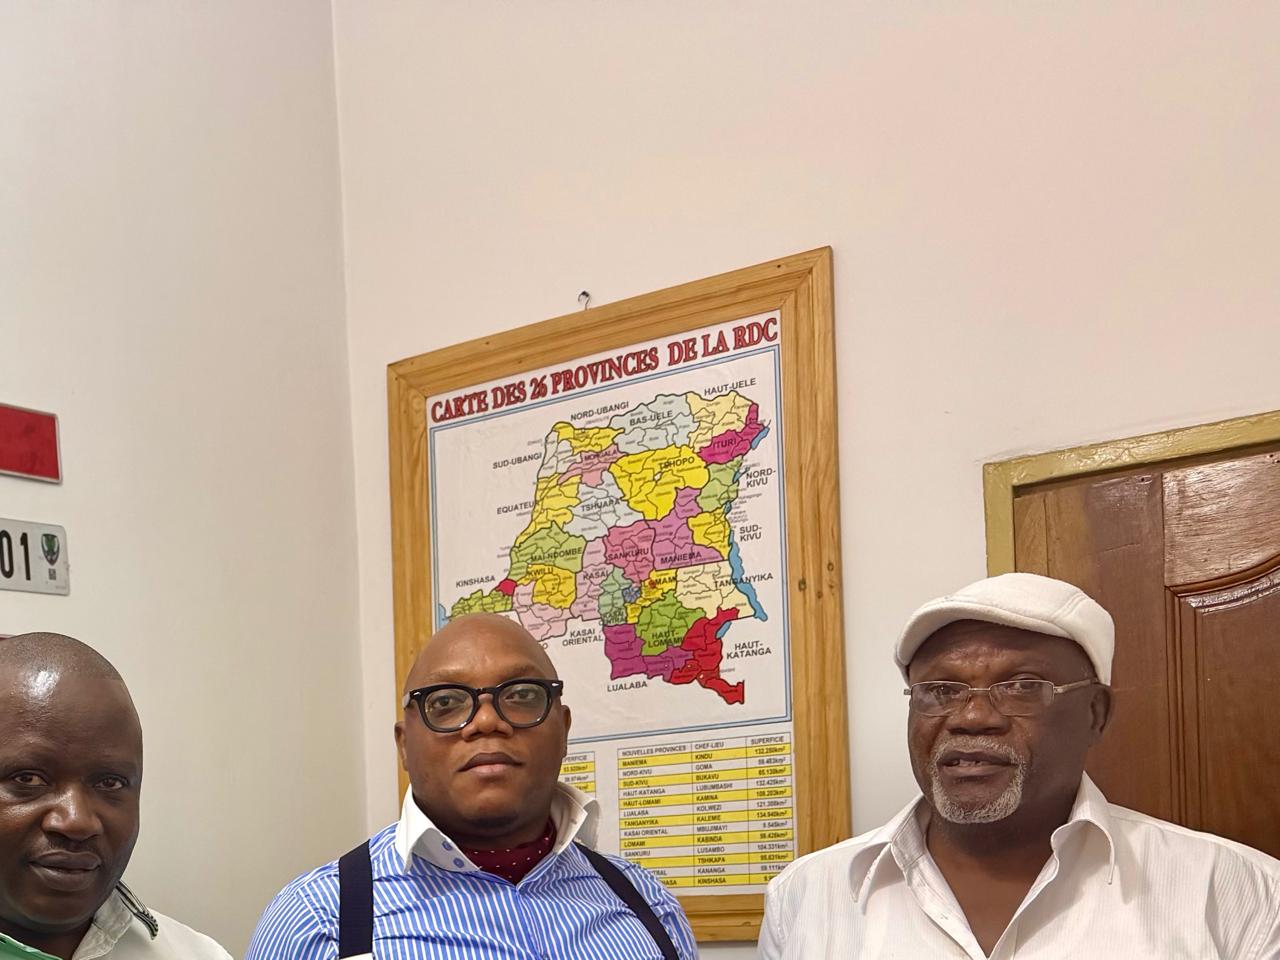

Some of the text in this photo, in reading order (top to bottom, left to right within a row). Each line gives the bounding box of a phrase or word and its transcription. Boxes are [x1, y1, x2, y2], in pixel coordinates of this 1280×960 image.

[431, 317, 778, 423] CARTE DES 26 PROVINCES DE LA RDC
[704, 378, 756, 396] HAUT-UELE
[570, 401, 629, 421] NORD-UBANGI
[629, 411, 673, 426] BAS-UELE
[713, 438, 737, 450] ITURI
[492, 452, 542, 470] SUD-UBANGI
[746, 468, 776, 480] NORD-
[746, 477, 768, 488] KIVU
[581, 499, 621, 512] TSHUAPA
[740, 524, 762, 535] SUD-
[740, 532, 762, 542] KIVU
[531, 547, 582, 560] MAI-NDOMBE
[608, 548, 649, 560] SANKURU
[660, 551, 702, 564] MANIEMA
[583, 570, 609, 580] KASAI
[456, 575, 495, 588] KINSHASA
[570, 628, 595, 637] KASAI
[562, 635, 603, 647] ORIENTAL
[734, 641, 763, 651] HAUT-
[726, 647, 772, 660] KATANGA
[607, 681, 648, 693] LUALABA
[695, 742, 724, 750] CHEF-LIEU
[751, 736, 784, 745] SUPERFICIE
[622, 745, 686, 757] NOUVELLES PROVINCES
[622, 769, 652, 777] NORD-KIVU
[696, 773, 719, 781] BUKAVU
[623, 788, 666, 796] HAUT-KATANGA
[623, 799, 661, 807] HAUT-LOMAMI
[697, 804, 722, 812] KOLWEZI
[641, 828, 668, 836] ORIENTAL
